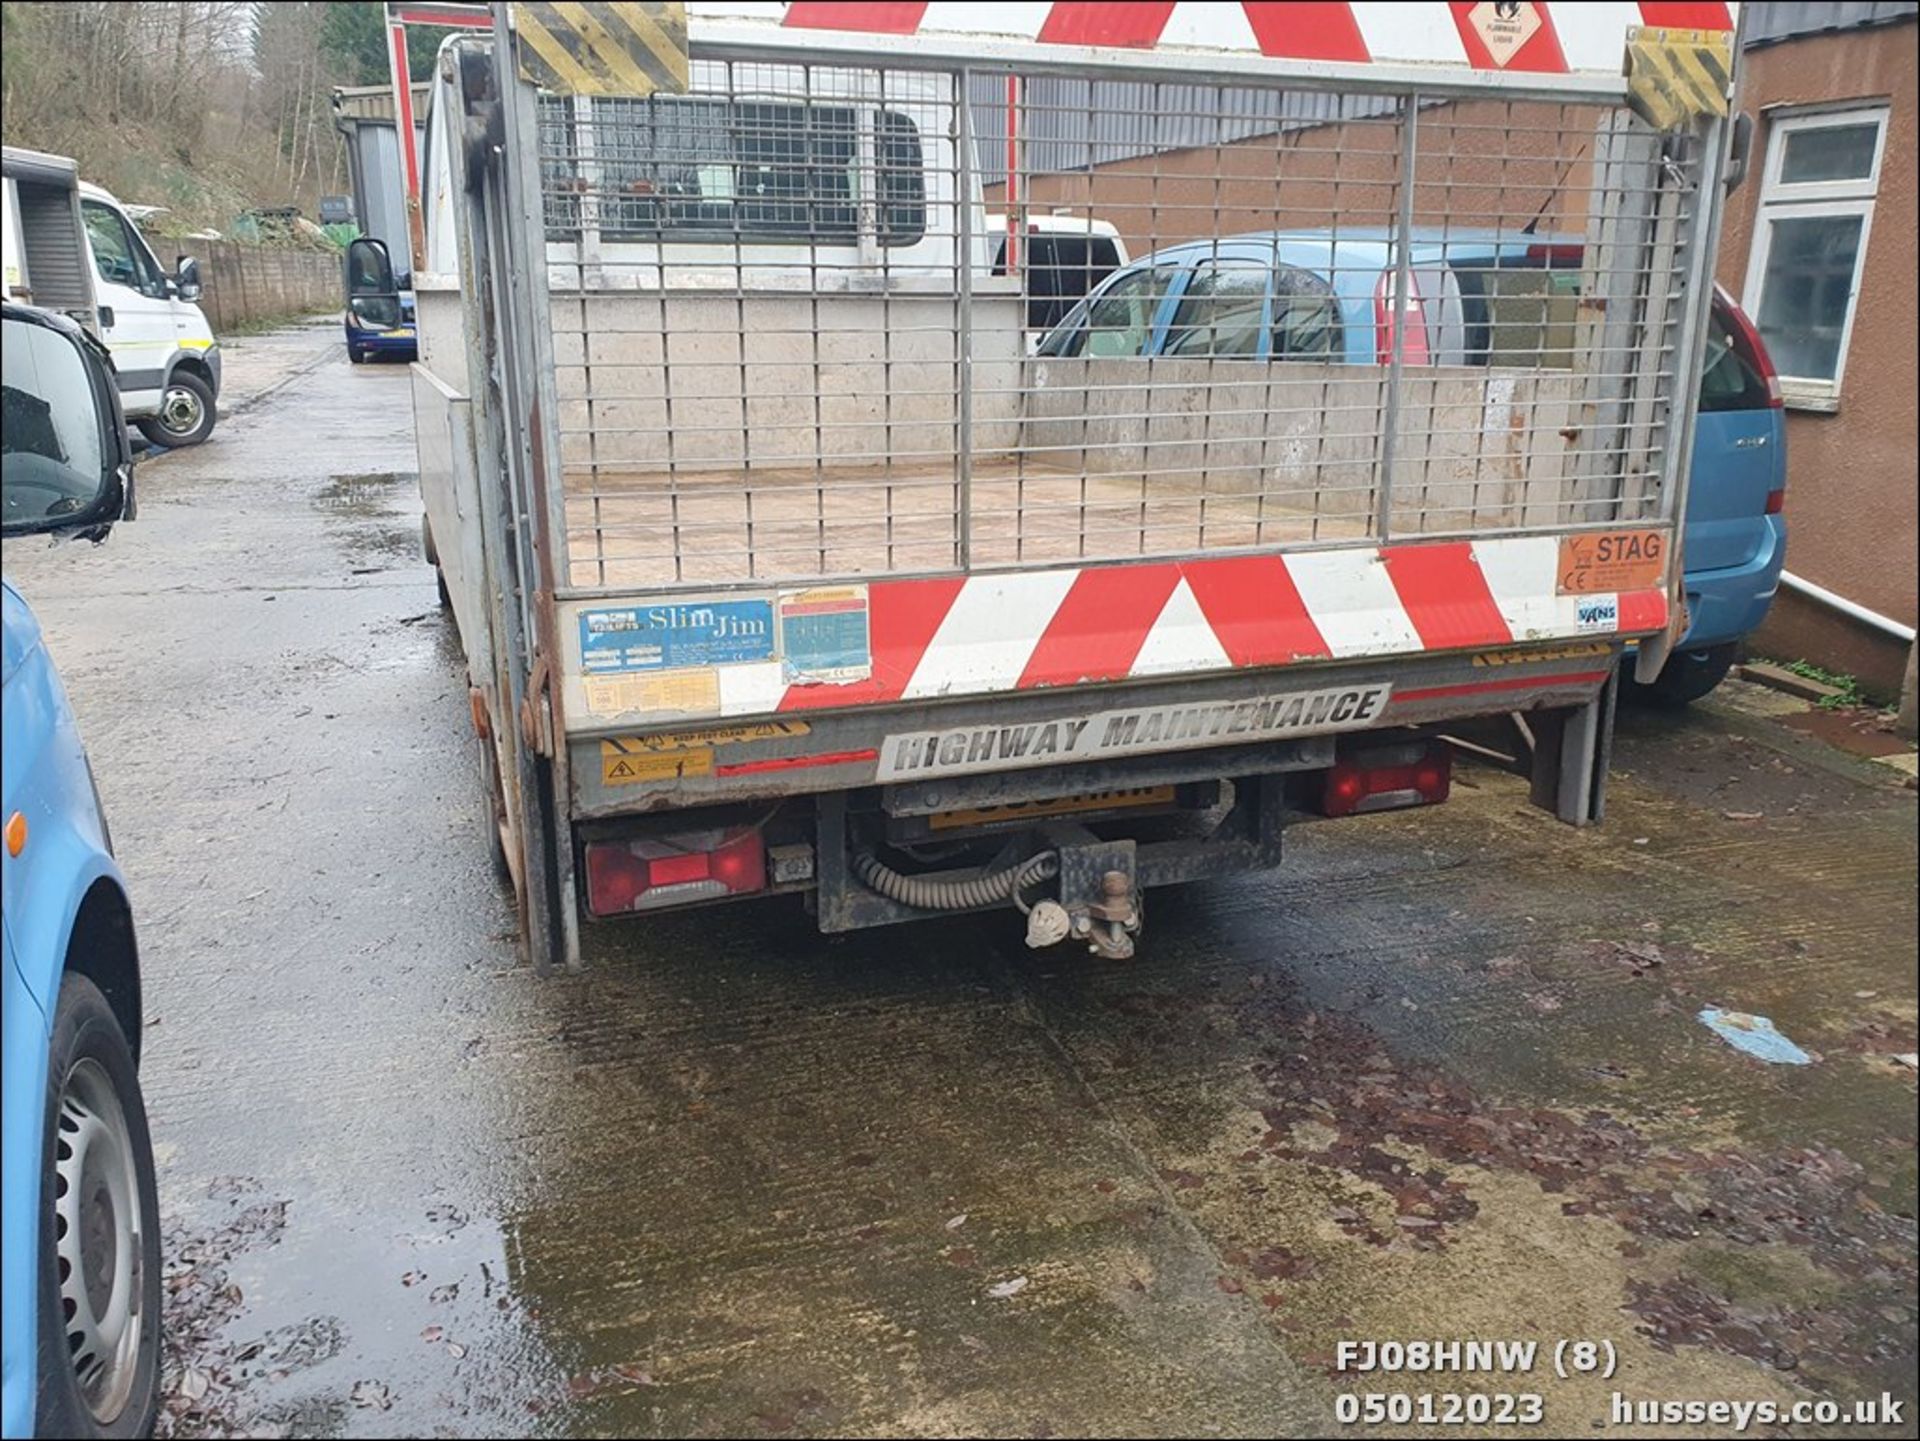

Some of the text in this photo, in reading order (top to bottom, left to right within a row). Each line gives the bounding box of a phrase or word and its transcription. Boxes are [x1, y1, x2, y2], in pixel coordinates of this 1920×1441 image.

[1597, 533, 1660, 562] STAG
[648, 607, 716, 630] Slim
[713, 615, 765, 638] Jim
[1578, 605, 1616, 623] VANS
[894, 690, 1381, 770] HIGHWAY MAINTENANCE
